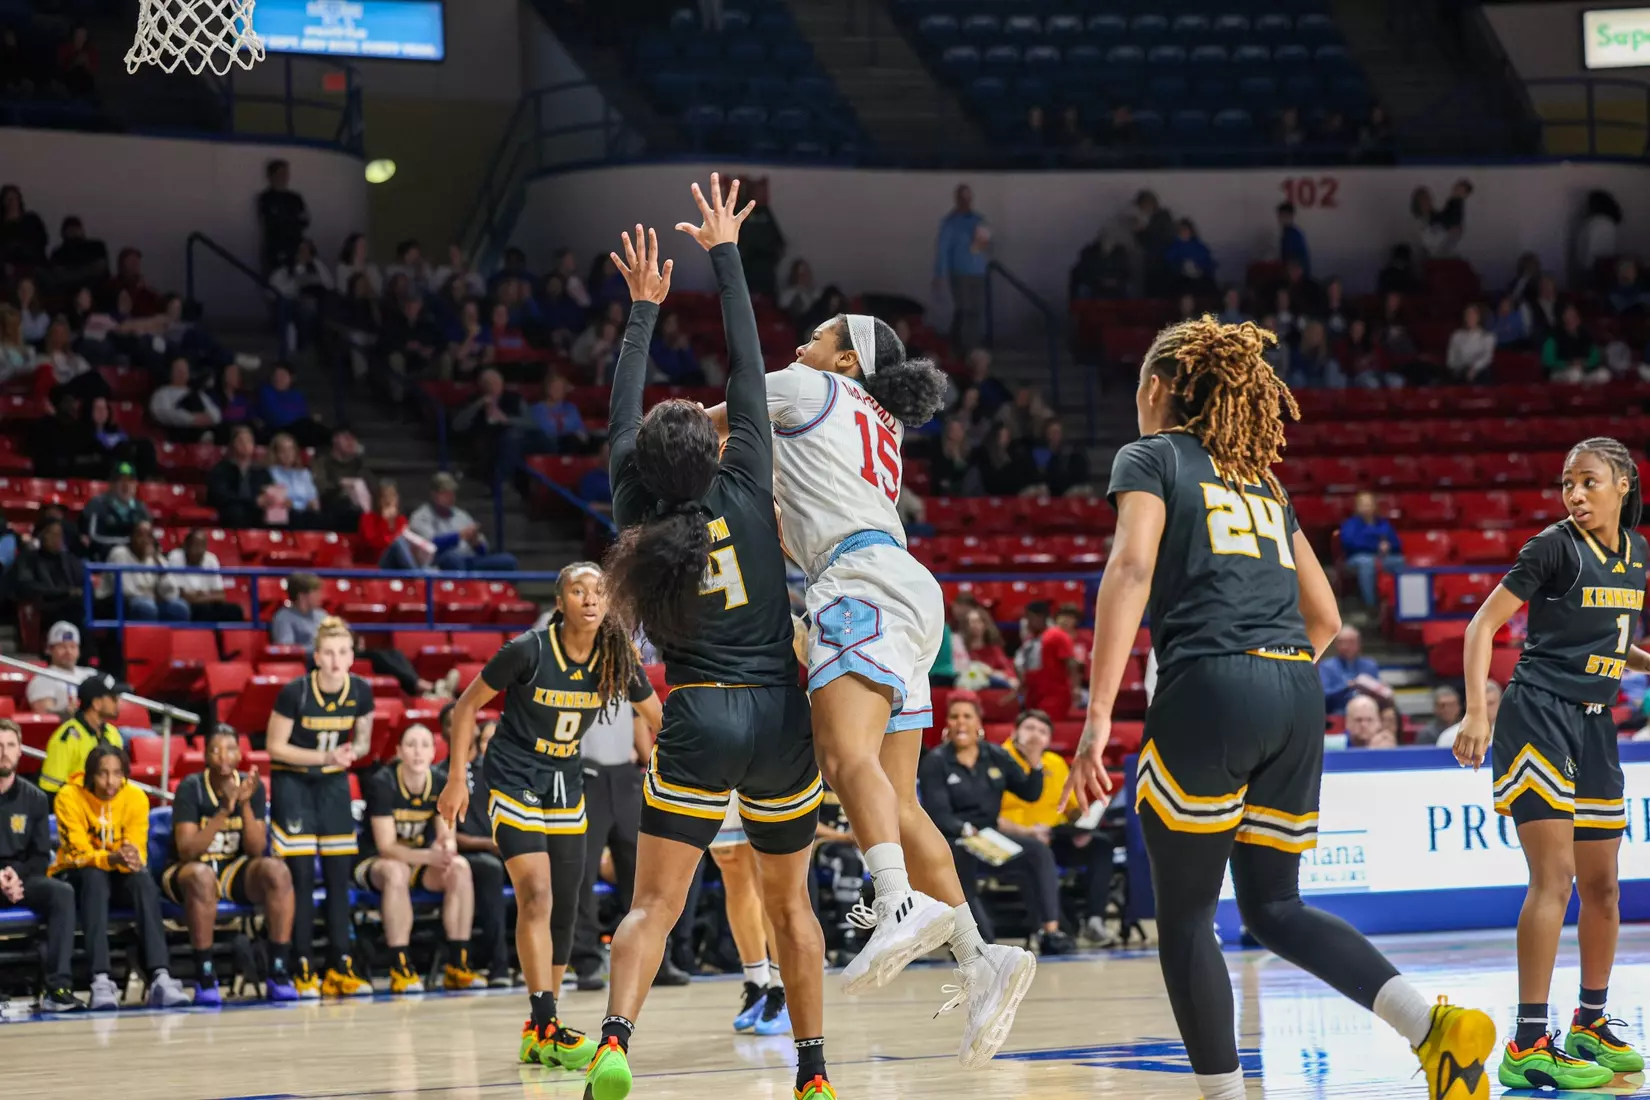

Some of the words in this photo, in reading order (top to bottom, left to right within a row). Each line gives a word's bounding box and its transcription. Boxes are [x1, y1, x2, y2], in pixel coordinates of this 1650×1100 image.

[1280, 176, 1340, 209] 102
[855, 410, 900, 504] 15
[1199, 482, 1297, 571] 24
[698, 544, 750, 610] 4
[1580, 586, 1645, 611] KENNESA
[1614, 613, 1630, 655] 1
[1584, 654, 1627, 680] STA
[532, 686, 603, 709] KENNESA
[554, 711, 582, 742] 0
